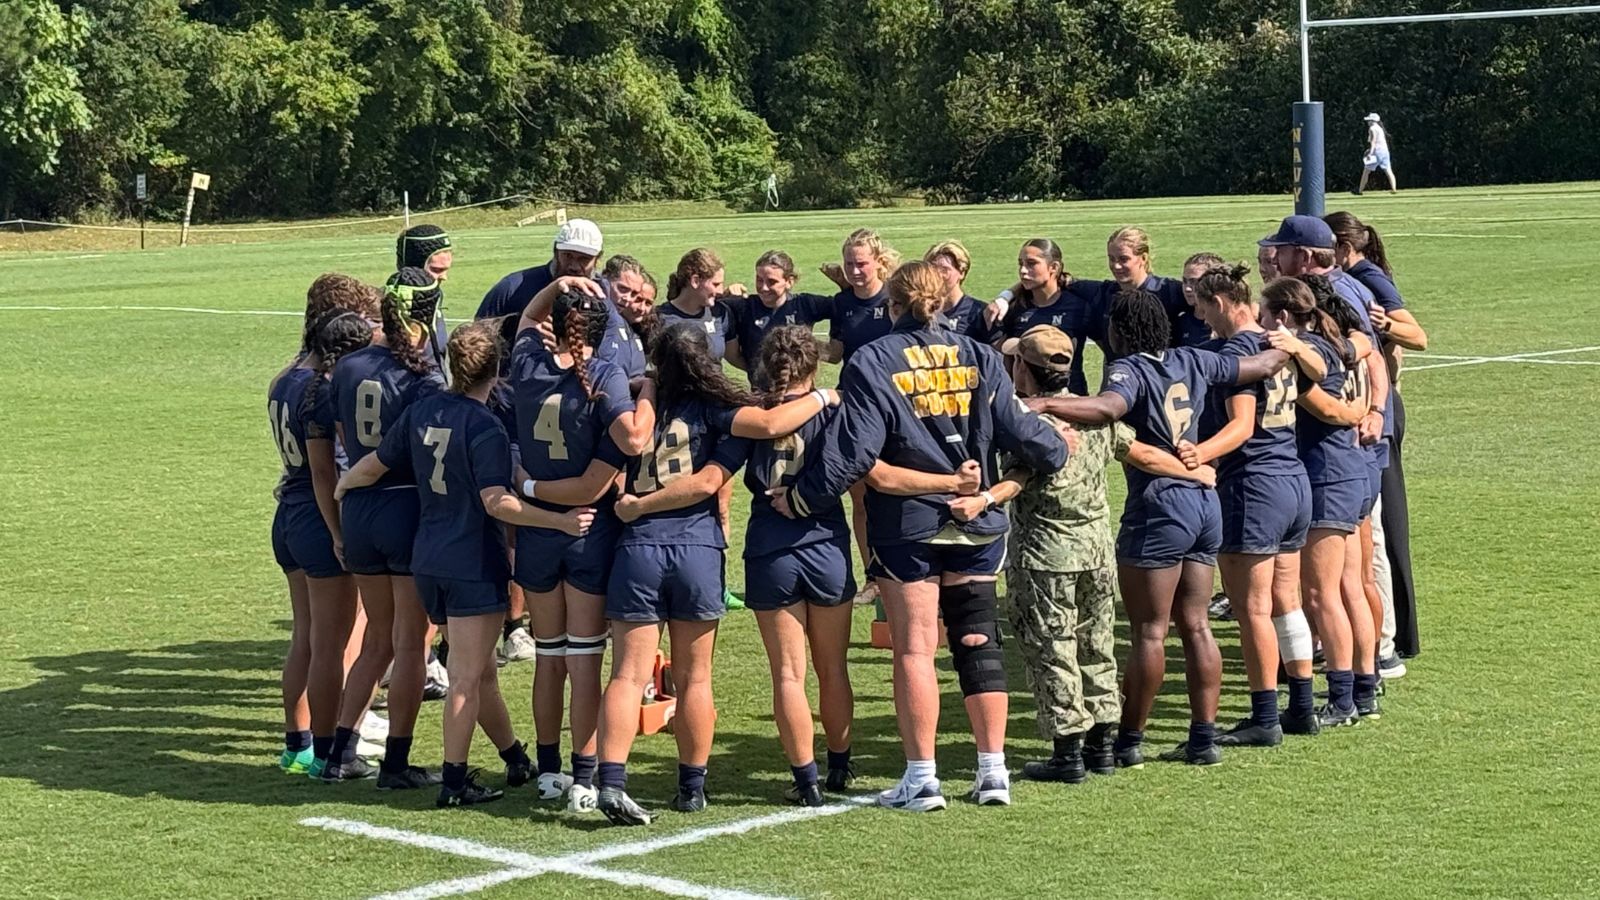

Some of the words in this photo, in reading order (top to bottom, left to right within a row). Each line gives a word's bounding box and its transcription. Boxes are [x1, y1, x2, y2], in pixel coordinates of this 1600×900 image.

[269, 400, 304, 467] 16
[356, 379, 383, 448] 8
[533, 393, 569, 460] 4
[1164, 382, 1195, 447] 6
[423, 426, 452, 495] 7
[633, 417, 693, 492] 18
[644, 682, 658, 699] G
